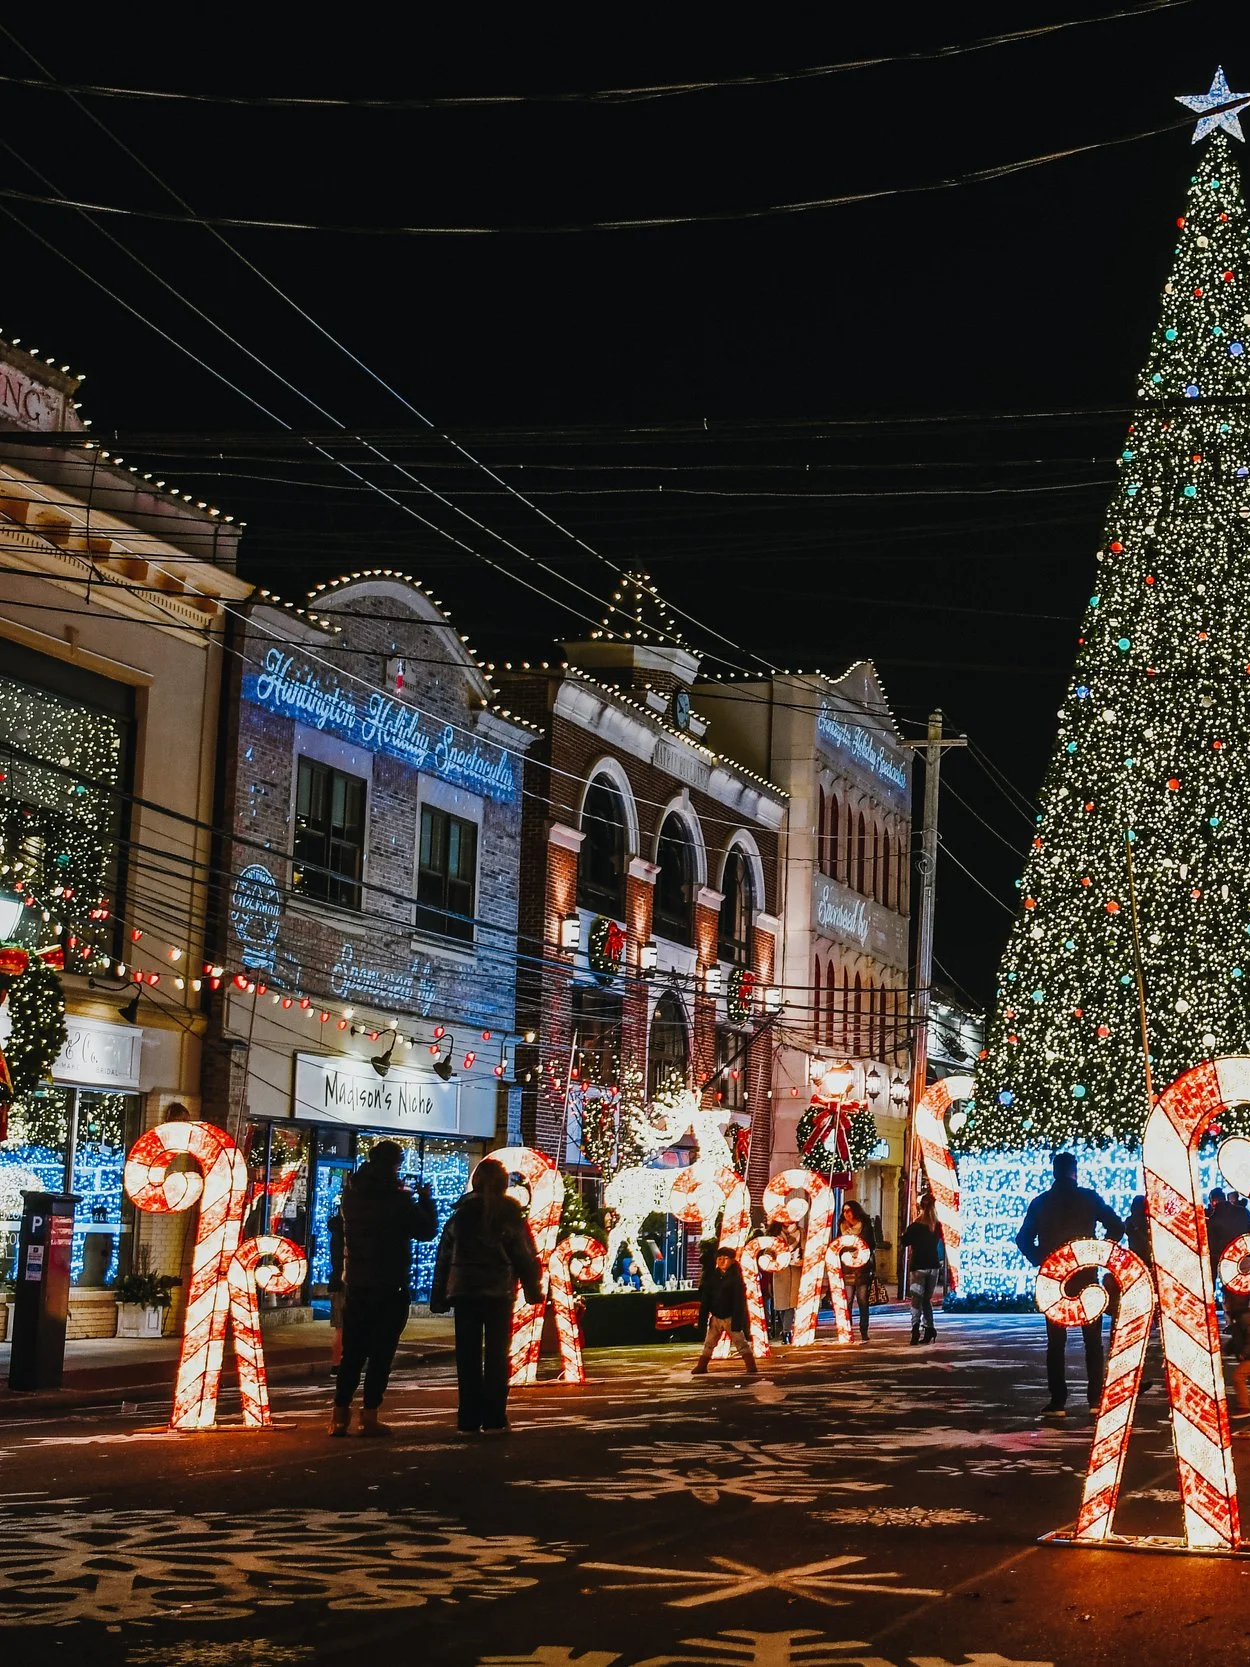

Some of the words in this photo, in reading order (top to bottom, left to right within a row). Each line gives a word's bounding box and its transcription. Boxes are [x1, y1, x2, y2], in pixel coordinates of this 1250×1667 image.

[2, 374, 41, 423] NG
[257, 647, 356, 729] Huntington
[362, 694, 431, 766] Holiday
[857, 902, 869, 947] by
[65, 1031, 80, 1060] &
[325, 1071, 392, 1111] Madison's
[398, 1081, 434, 1116] Niche
[32, 1216, 43, 1233] P
